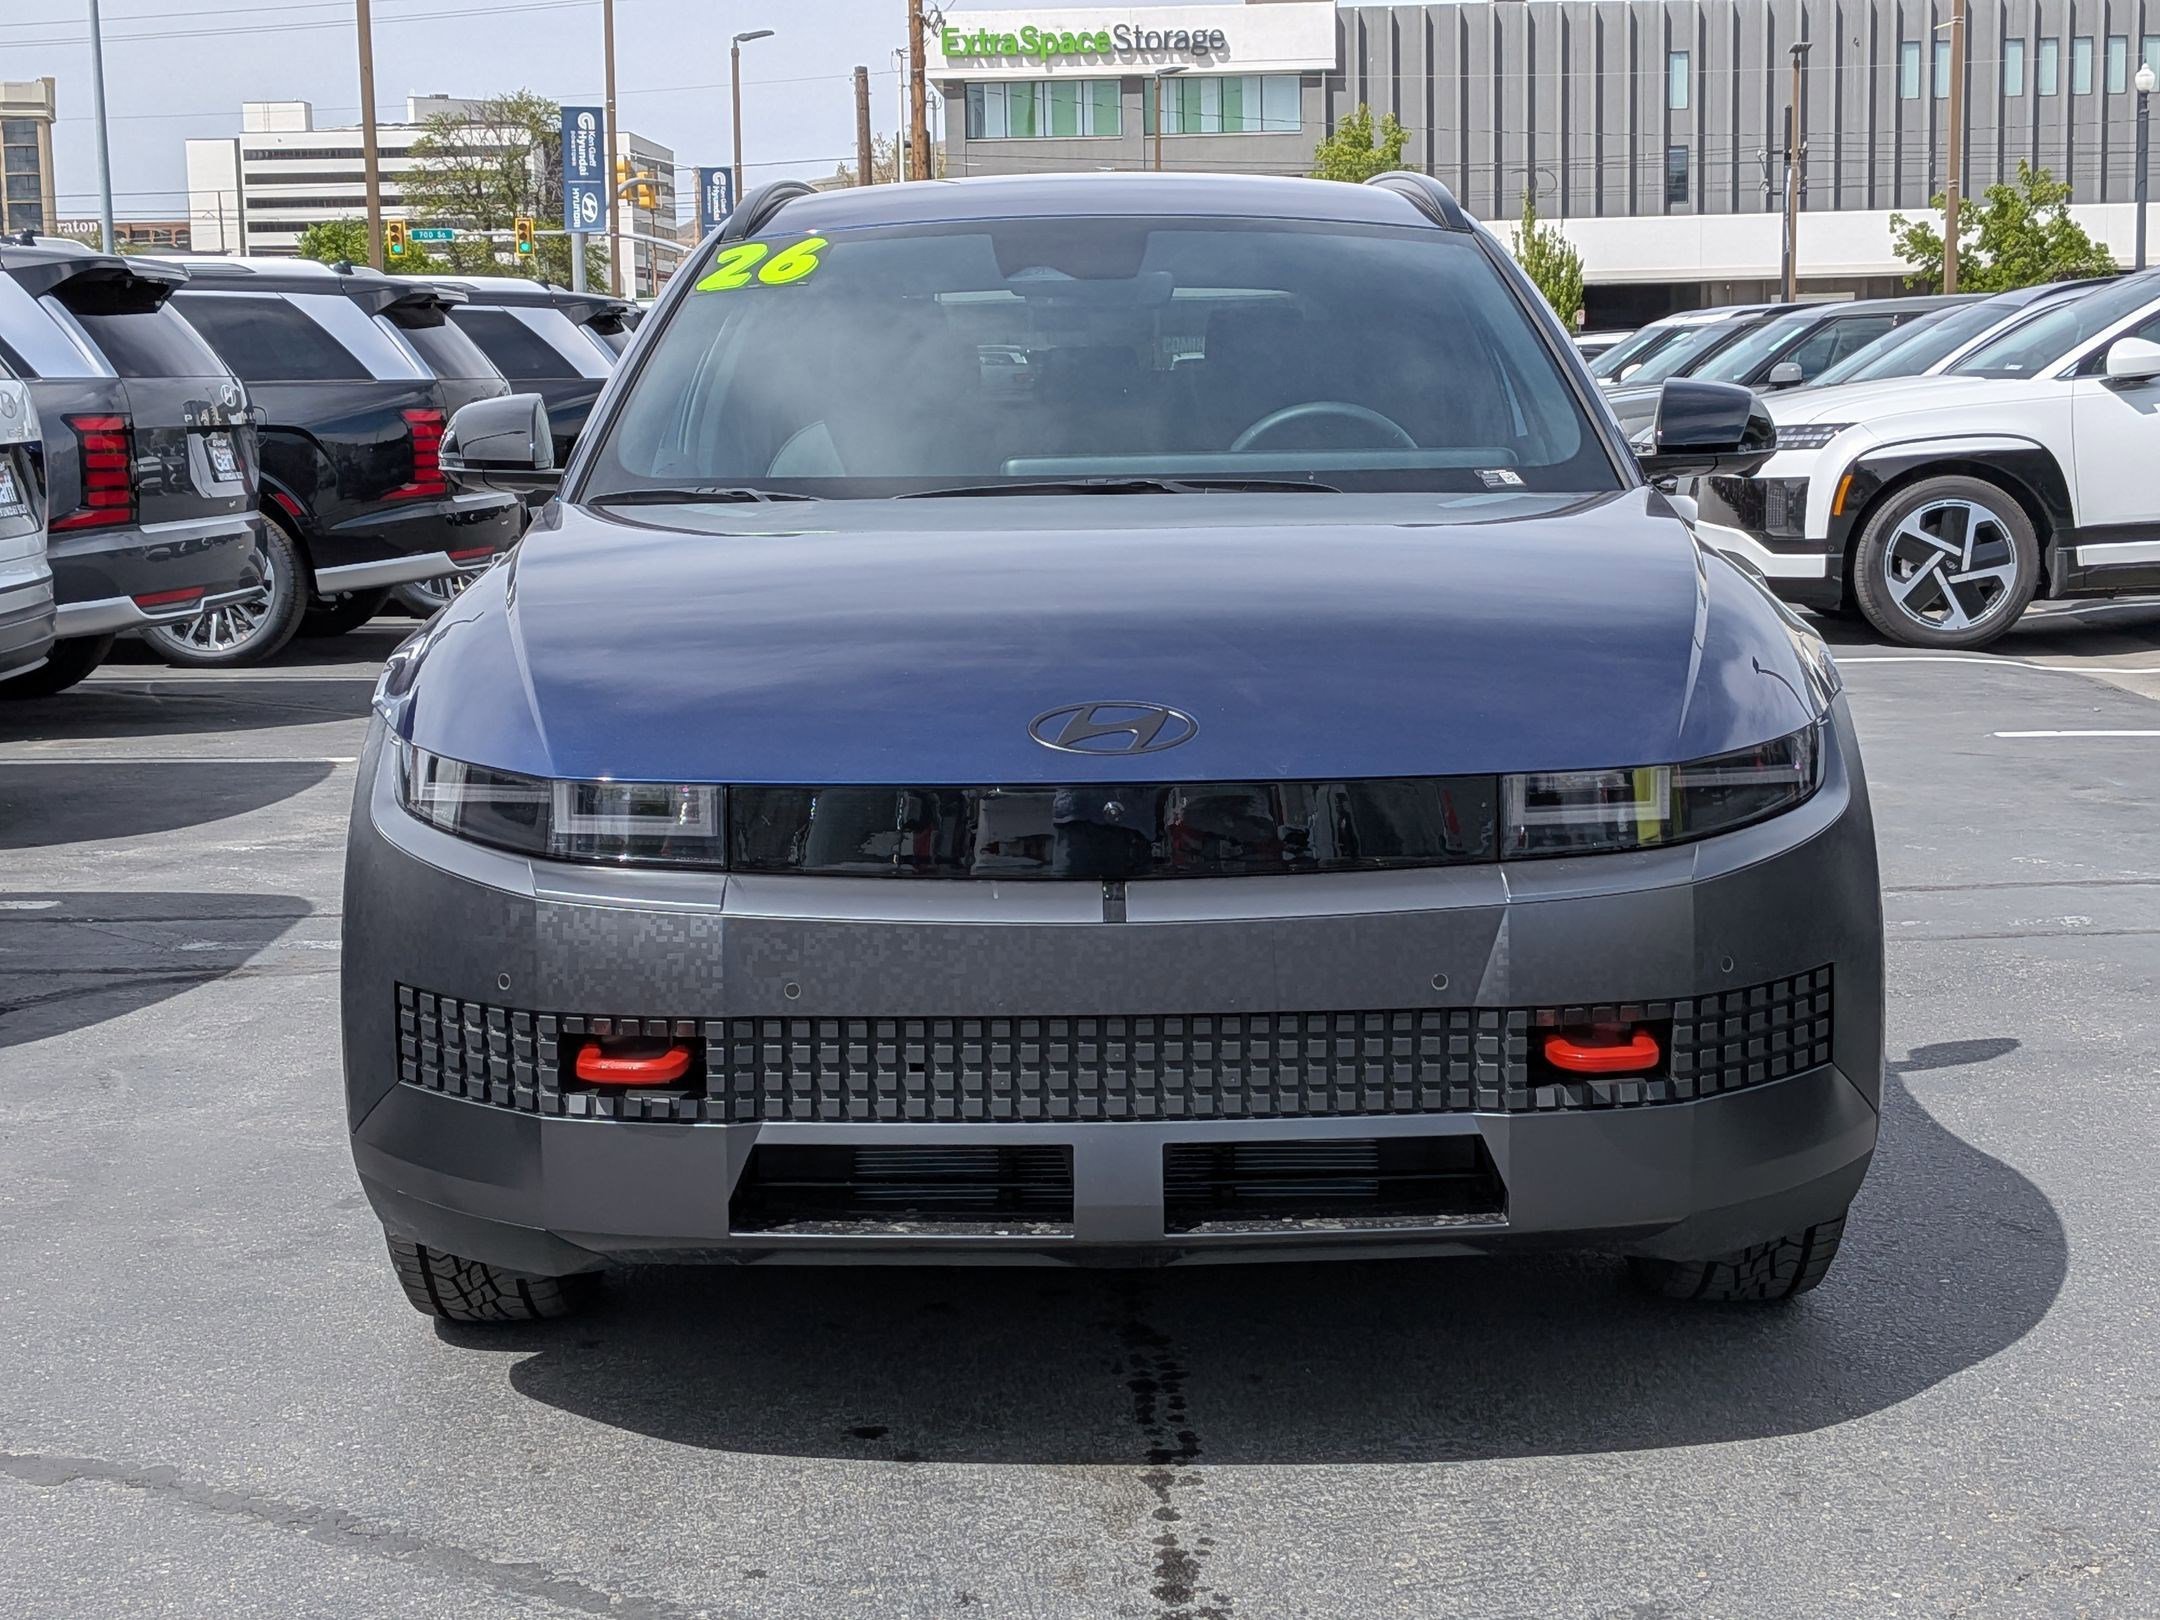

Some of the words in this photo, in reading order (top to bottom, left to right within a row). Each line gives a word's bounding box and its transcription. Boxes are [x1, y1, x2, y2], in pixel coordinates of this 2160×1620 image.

[576, 130, 589, 176] Hyundai
[419, 231, 434, 239] 700
[696, 236, 829, 292] 26
